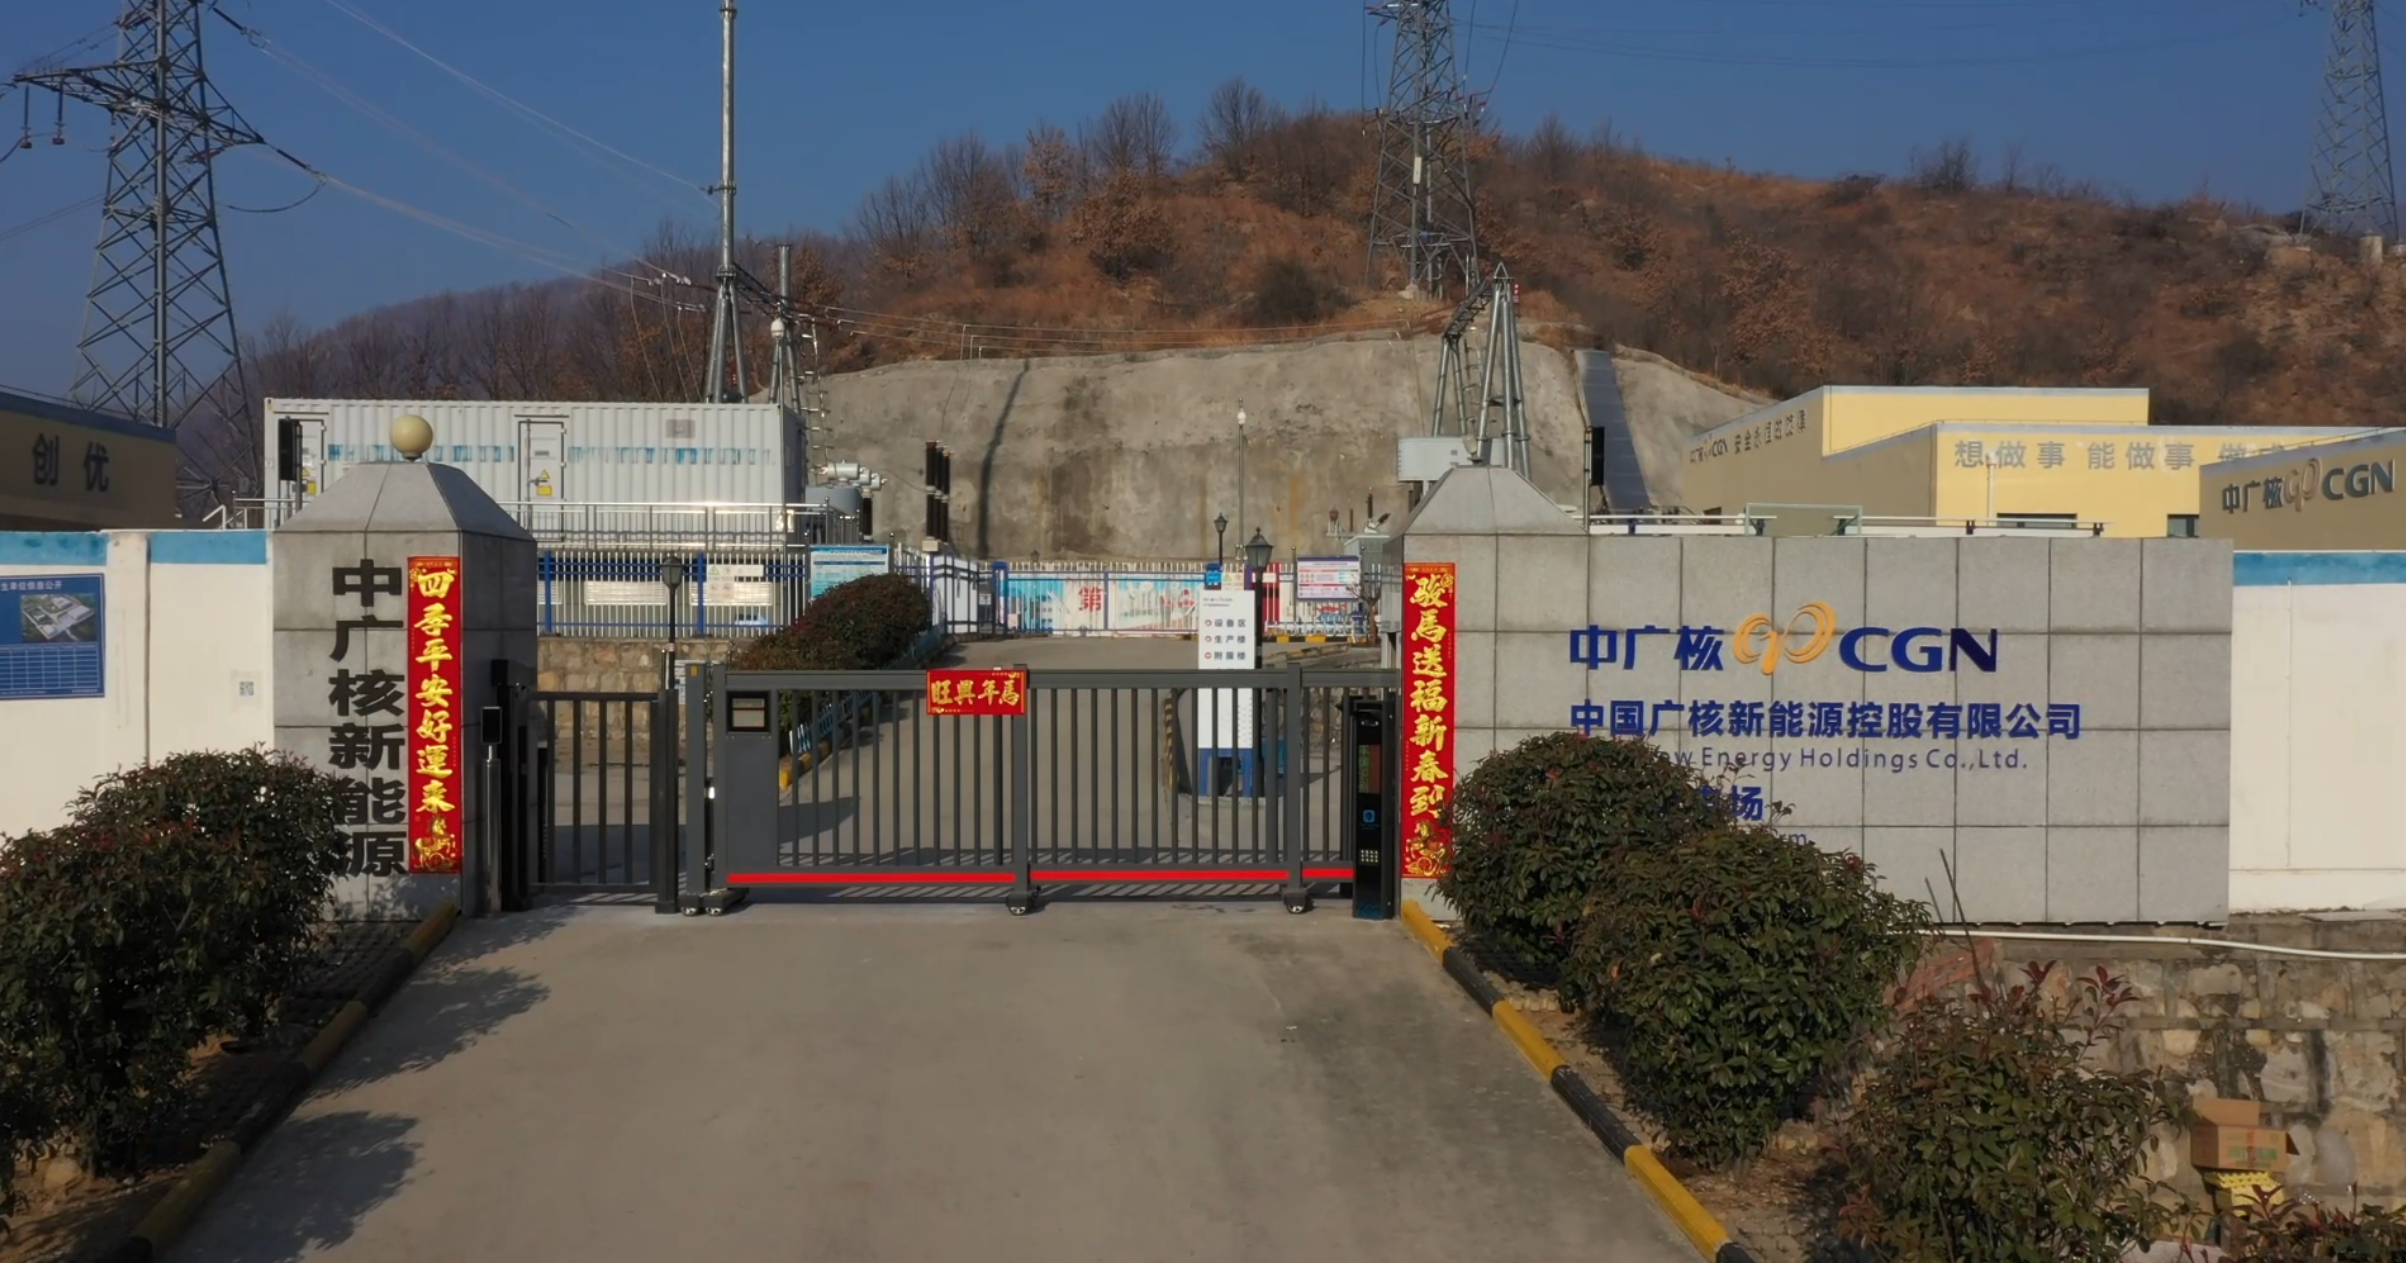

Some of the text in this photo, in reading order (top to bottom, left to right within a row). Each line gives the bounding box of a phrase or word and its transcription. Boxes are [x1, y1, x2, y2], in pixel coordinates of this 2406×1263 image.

[1955, 440, 2065, 470] 想做事
[2087, 441, 2195, 470] 能做事
[2222, 459, 2396, 514] 中广核 CGN
[1570, 624, 1998, 673] 中广核 CGN
[328, 558, 408, 878] 中广核新能源
[1571, 698, 2081, 740] 中国广核新能源控股有限公司
[1701, 746, 1792, 773] Energy
[1800, 747, 1918, 773] Holdings
